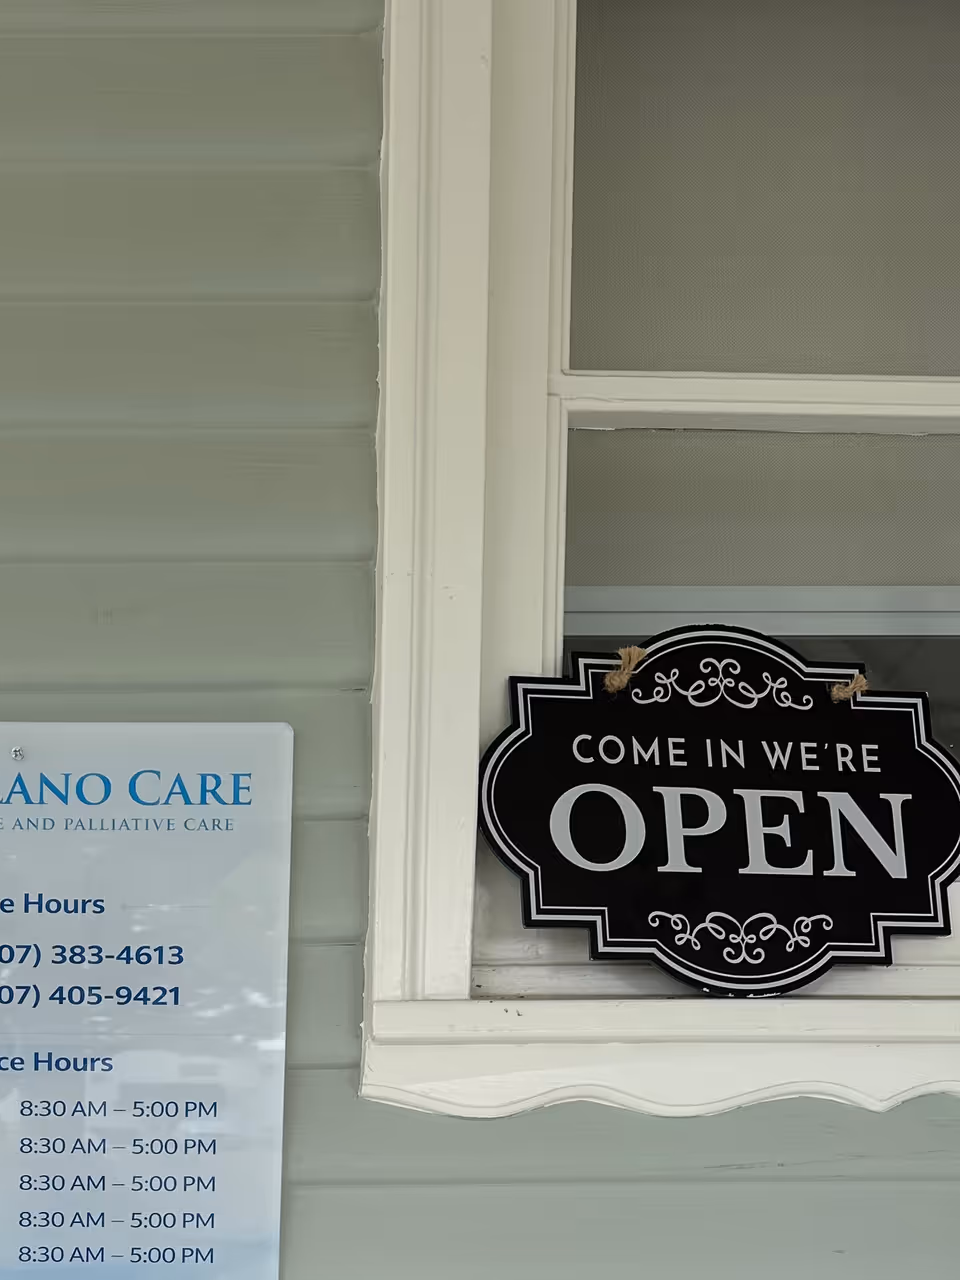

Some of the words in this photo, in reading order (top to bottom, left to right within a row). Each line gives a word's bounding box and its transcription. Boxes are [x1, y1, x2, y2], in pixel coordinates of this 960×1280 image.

[572, 734, 688, 767] COME
[705, 738, 745, 769] IN
[761, 740, 882, 773] WE'RE
[128, 769, 252, 806] CARE
[11, 817, 56, 831] AND
[64, 818, 175, 831] PALLIATIVE
[183, 817, 234, 831] CARE
[549, 783, 913, 879] OPEN
[23, 893, 105, 914] Hours
[51, 944, 184, 965] 383-4613
[48, 985, 180, 1006] 405-9421
[33, 1051, 113, 1072] Hours
[19, 1100, 67, 1117] 8:30
[70, 1100, 107, 1117] AM
[132, 1101, 179, 1118] 5:00
[185, 1101, 218, 1118] PM
[19, 1137, 66, 1154] 8:30
[70, 1138, 106, 1154] AM
[131, 1138, 178, 1155] 5:00
[184, 1138, 217, 1155] PM
[19, 1174, 66, 1191] 8:30
[70, 1175, 106, 1192] AM
[131, 1175, 177, 1192] 5:00
[183, 1175, 216, 1192] PM
[18, 1211, 65, 1228] 8:30
[69, 1211, 105, 1228] AM
[130, 1212, 177, 1229] 5:00
[182, 1212, 215, 1229] PM
[18, 1246, 65, 1263] 8:30
[69, 1246, 105, 1263] AM
[129, 1247, 176, 1264] 5:00
[181, 1247, 214, 1264] PM
